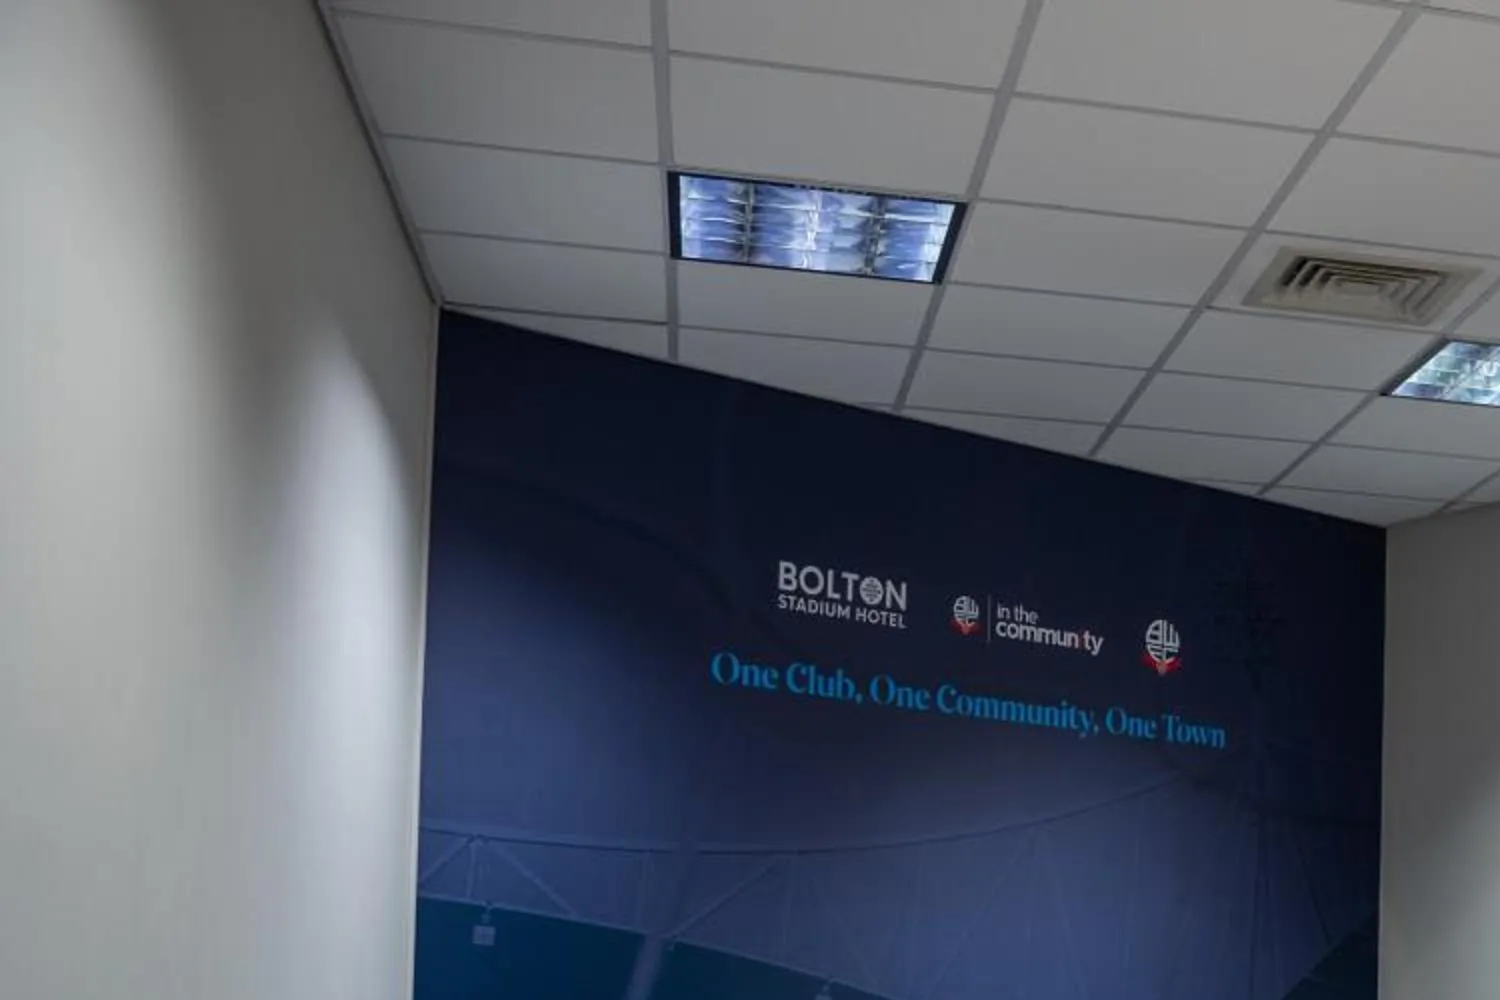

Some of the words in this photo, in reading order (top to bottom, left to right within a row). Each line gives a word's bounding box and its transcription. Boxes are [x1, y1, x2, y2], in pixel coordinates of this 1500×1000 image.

[778, 560, 908, 612] BOLTON
[778, 593, 851, 620] STADIUM
[855, 607, 908, 629] HOTEL
[1013, 604, 1040, 625] the
[711, 652, 778, 690] One
[869, 674, 929, 711] One
[1105, 707, 1157, 738] One
[1160, 714, 1226, 749] Town
